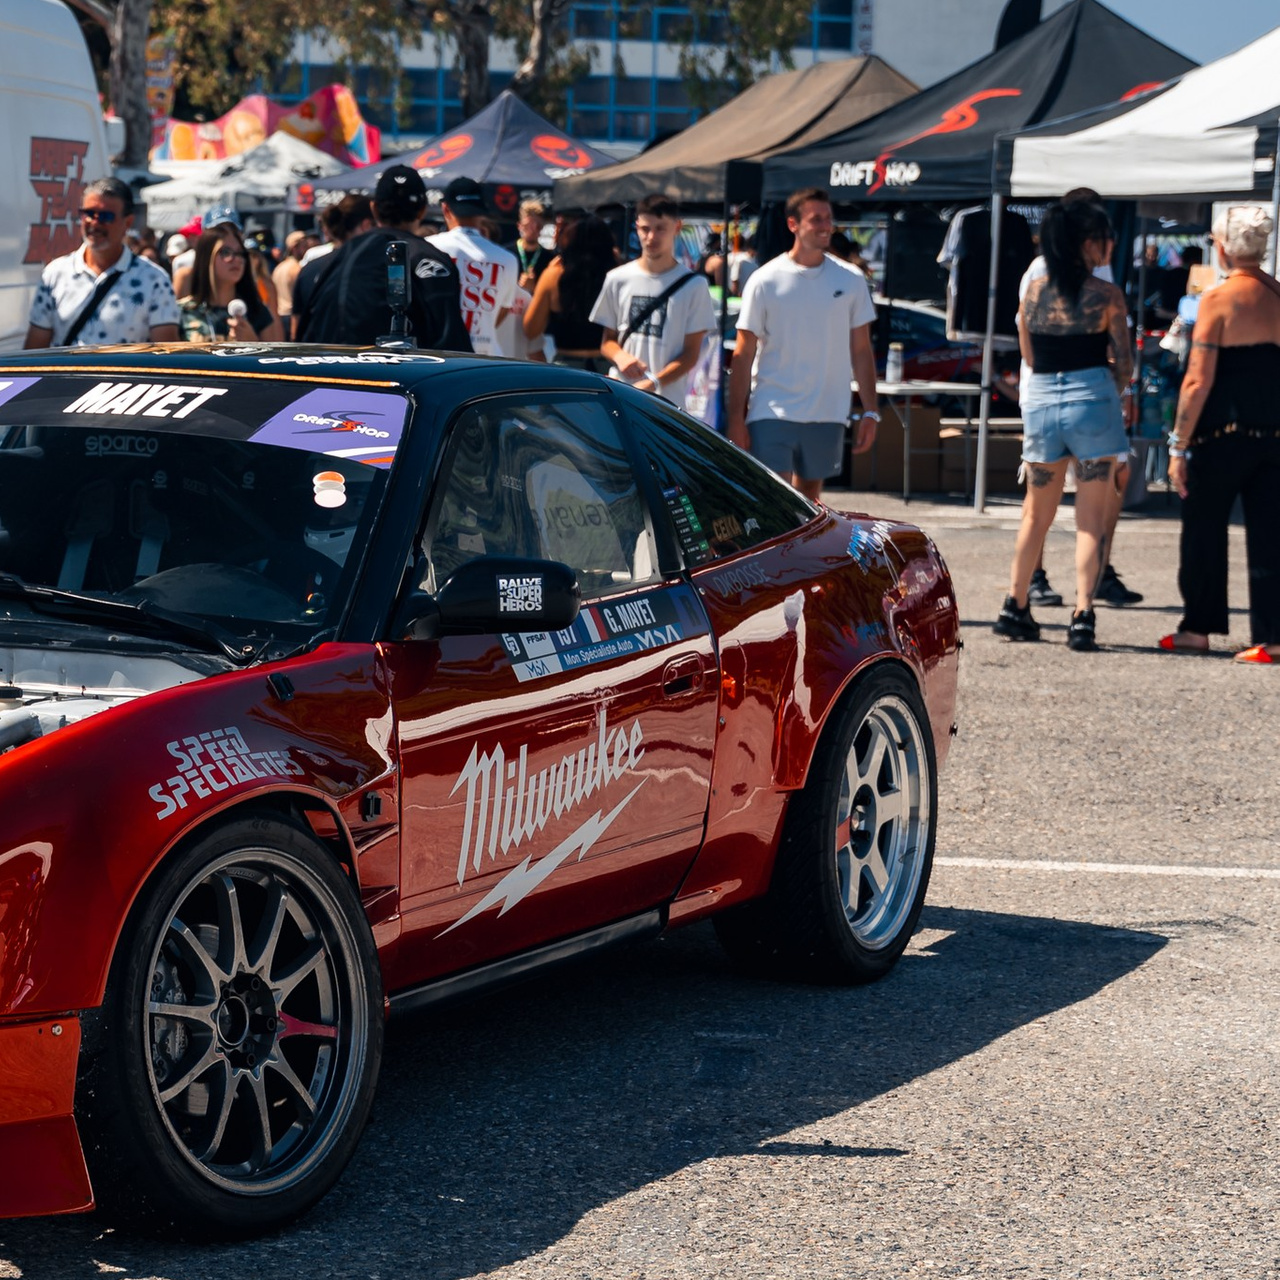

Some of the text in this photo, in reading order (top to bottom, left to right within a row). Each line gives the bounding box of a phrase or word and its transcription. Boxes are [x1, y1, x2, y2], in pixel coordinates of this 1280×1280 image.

[29, 136, 89, 181] DRIFT
[29, 177, 88, 224] TEA
[460, 284, 497, 313] SS
[62, 382, 228, 419] MAYET
[85, 434, 159, 457] sparco
[499, 577, 542, 591] RALLYE
[506, 584, 542, 603] SUPER
[499, 598, 543, 612] HEROS
[603, 608, 622, 634] G.
[621, 598, 657, 629] MAYET
[563, 650, 579, 666] Mon
[580, 642, 618, 663] Spécialiste
[618, 637, 634, 654] Auto
[166, 726, 251, 773] SPEED
[148, 750, 306, 821] SPECIALTIES
[449, 709, 645, 887] Milwaukee
